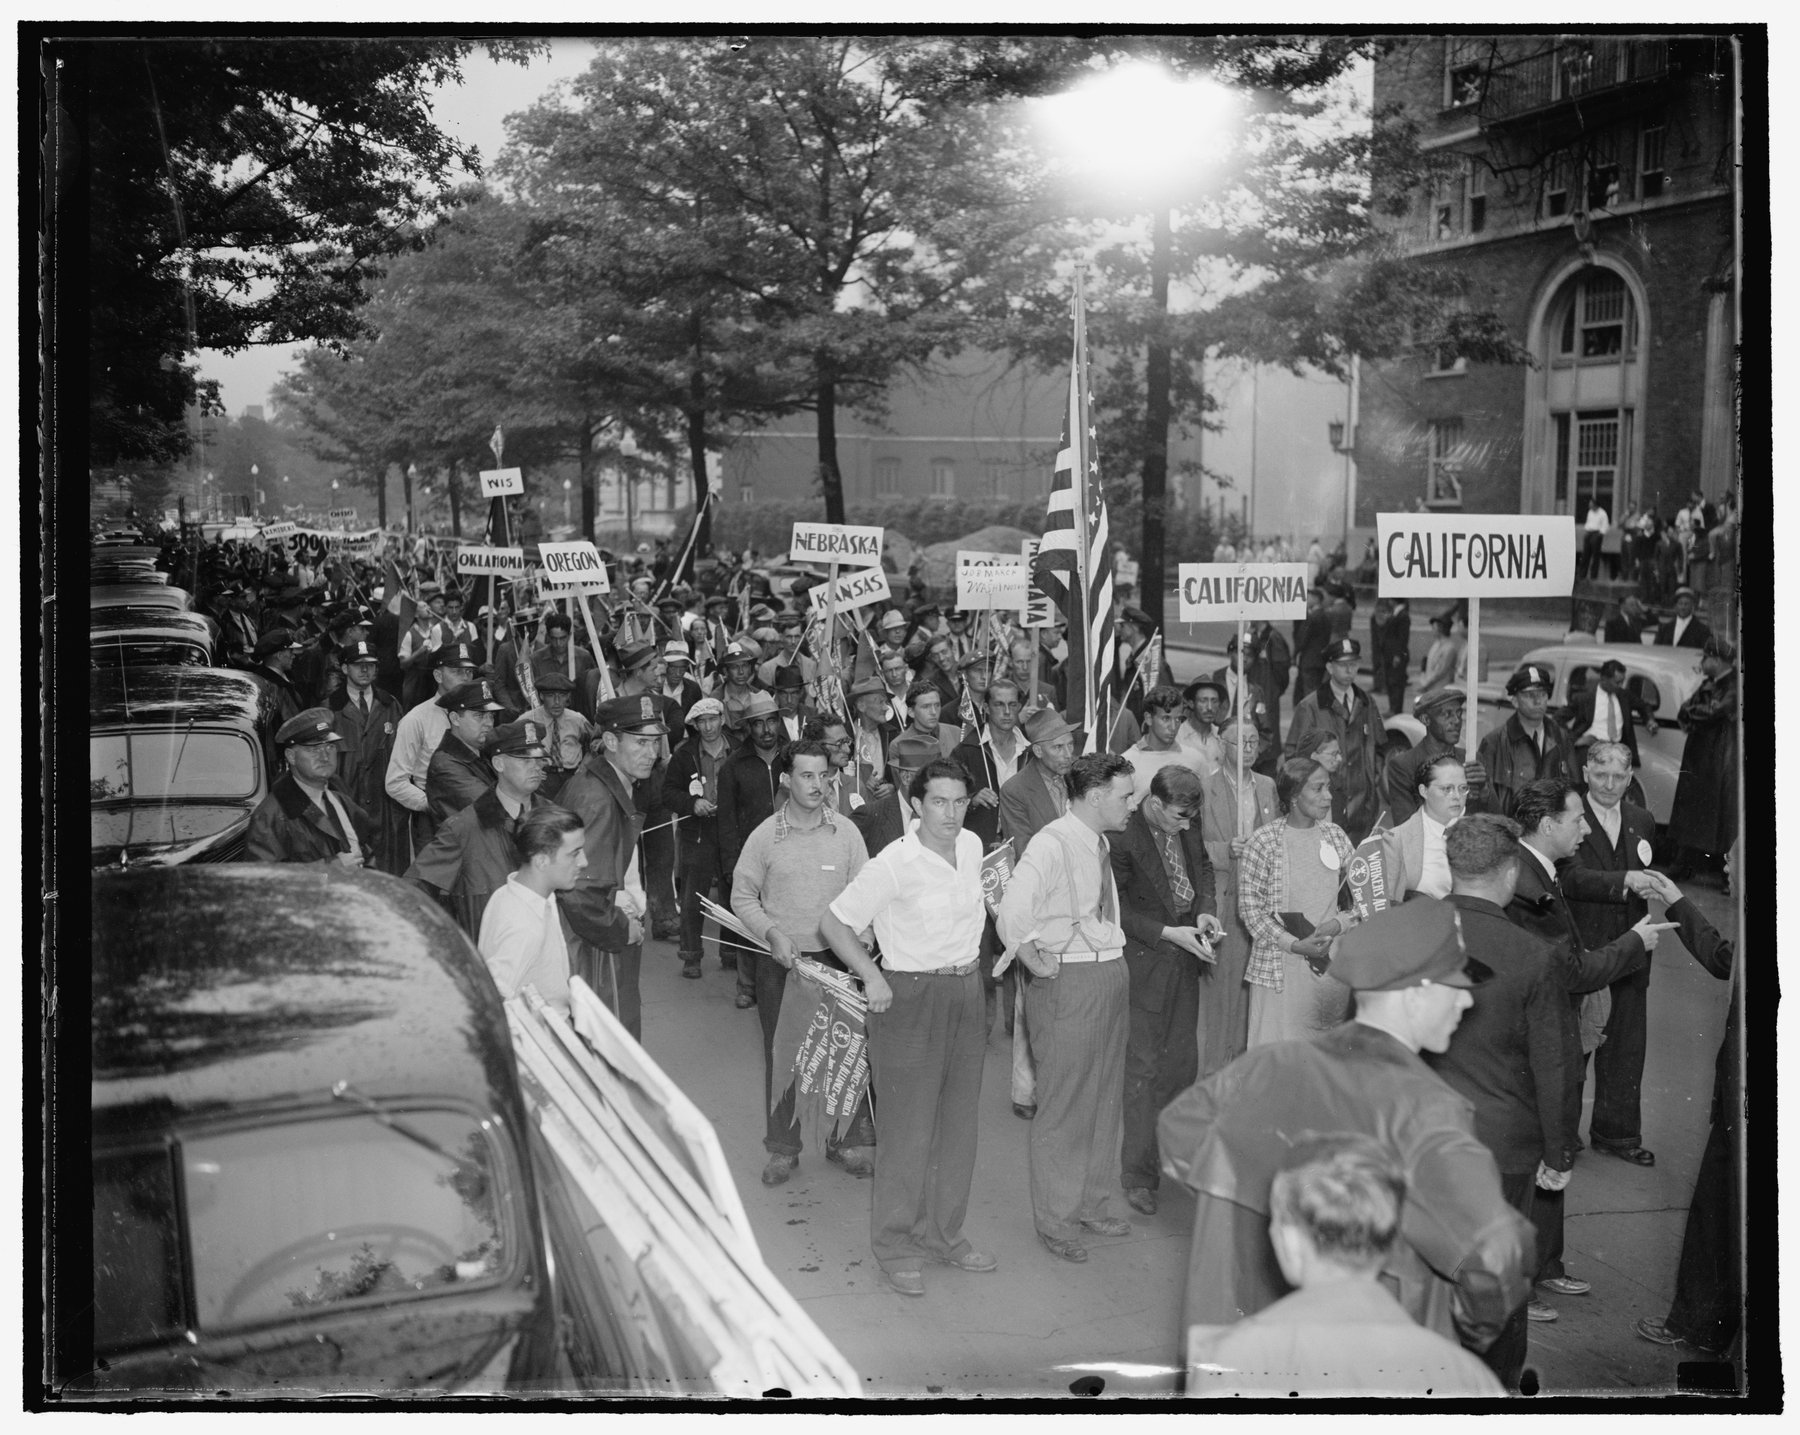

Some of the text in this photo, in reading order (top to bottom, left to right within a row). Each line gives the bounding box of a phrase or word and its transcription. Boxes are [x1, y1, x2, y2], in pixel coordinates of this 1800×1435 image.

[487, 477, 513, 489] WIS
[795, 532, 879, 556] NEBRASKA
[1386, 531, 1548, 579] CALIFORNIA
[459, 553, 523, 569] OKLAHOMA
[546, 551, 600, 573] OREGON
[1184, 575, 1307, 605] CALIFORNIA
[1367, 850, 1385, 897] WORKERS
